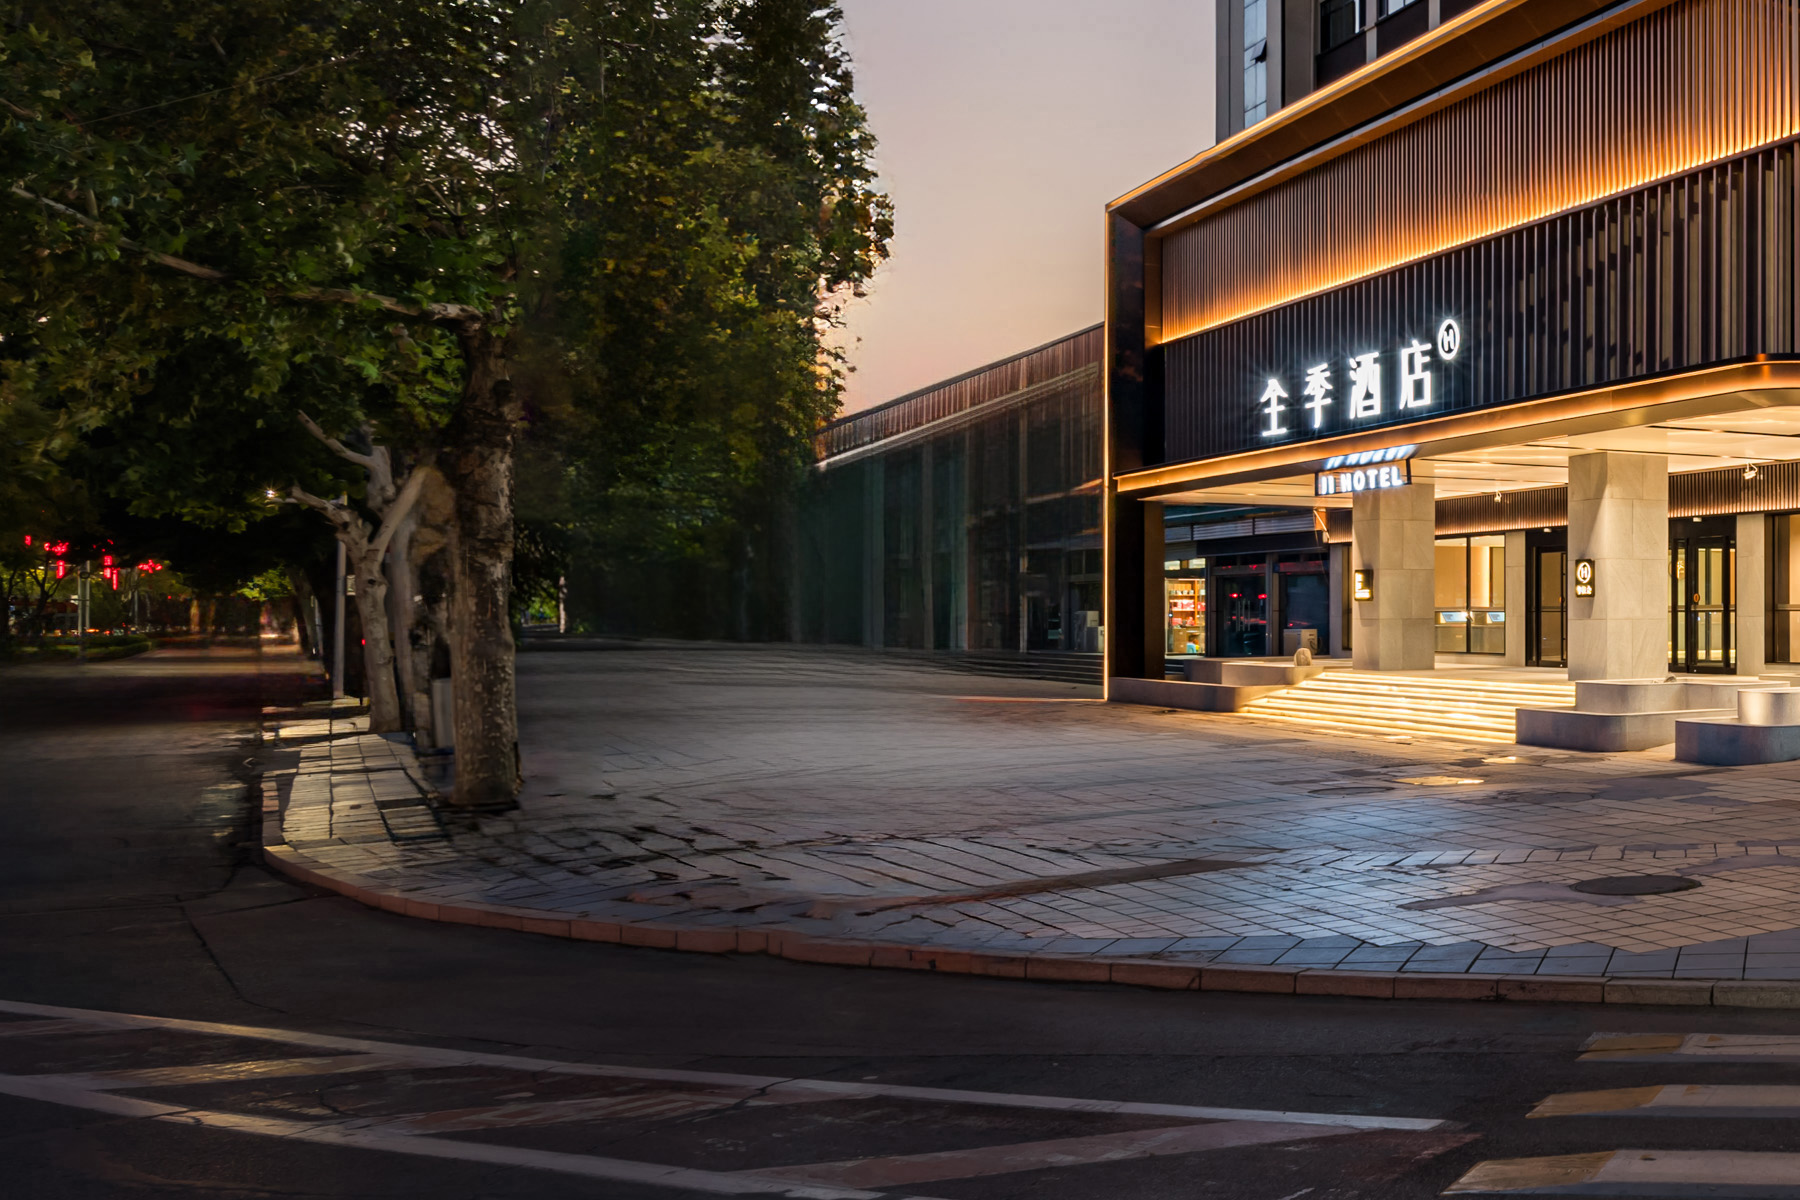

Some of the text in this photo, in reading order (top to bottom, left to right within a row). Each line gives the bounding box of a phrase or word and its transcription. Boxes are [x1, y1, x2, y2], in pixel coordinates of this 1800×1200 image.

[1260, 339, 1432, 435] 全季酒店
[1340, 465, 1403, 492] HOTEL
